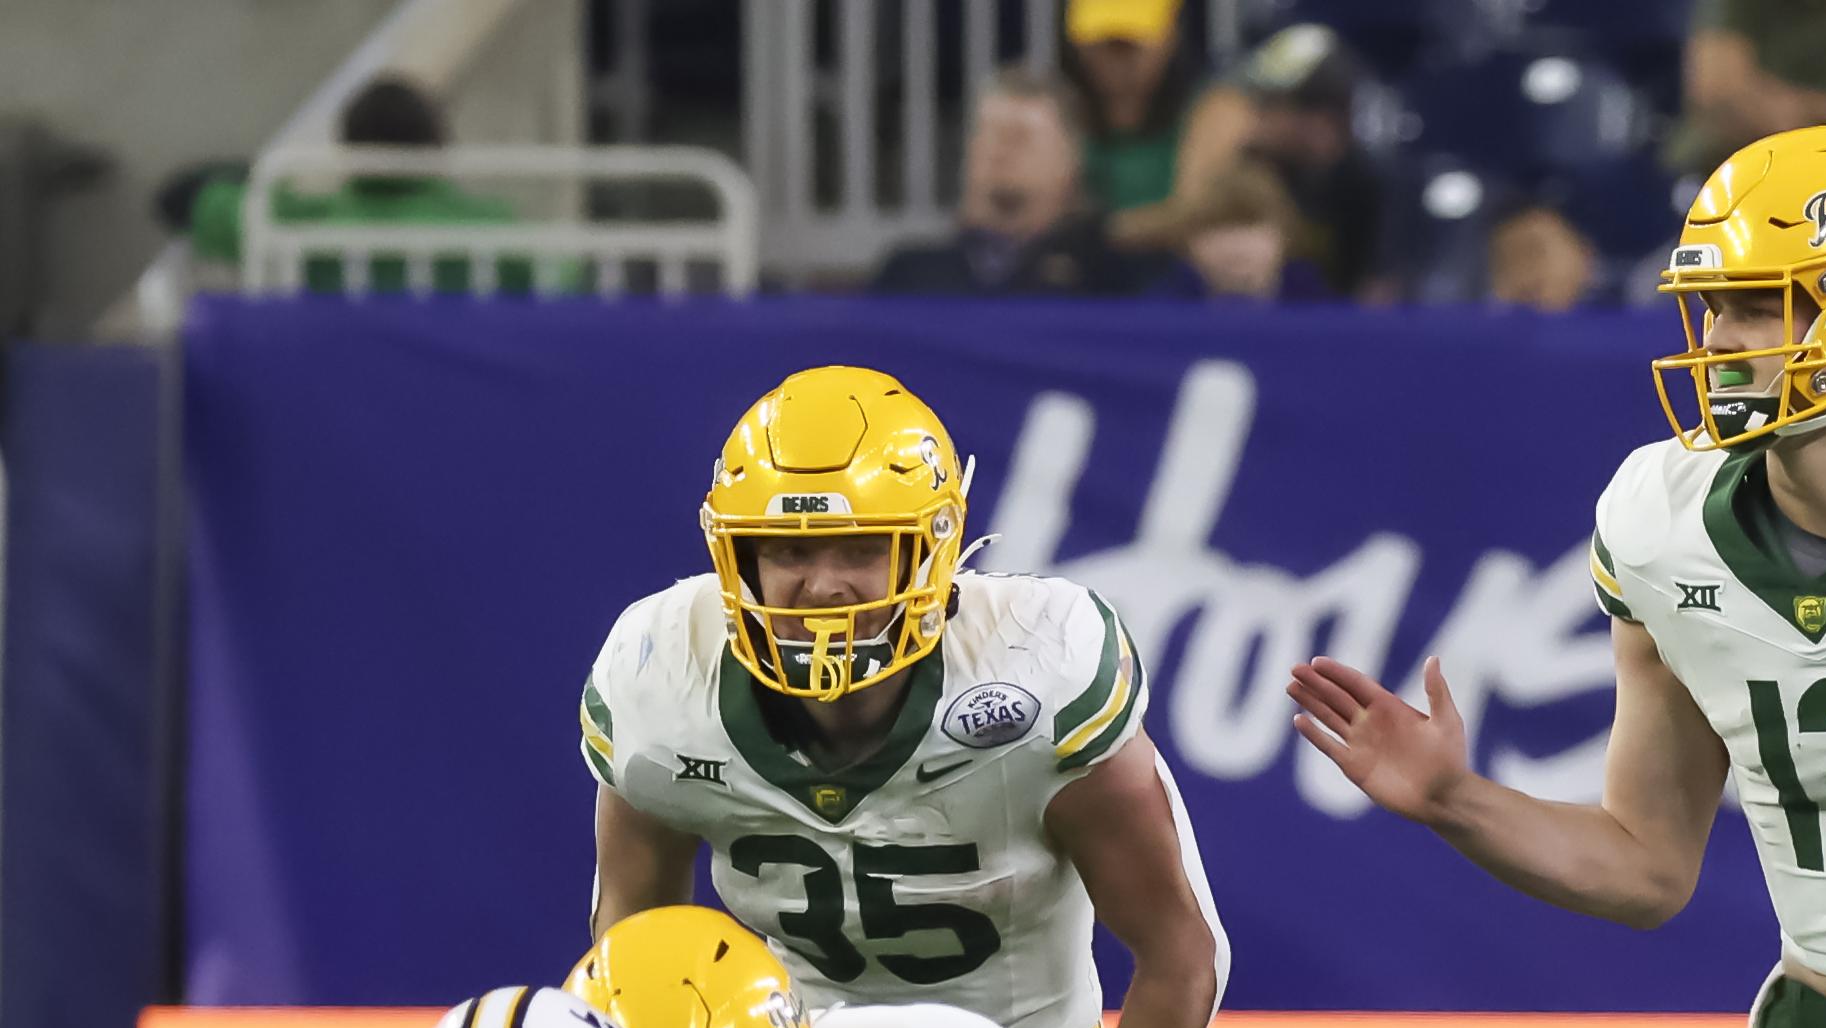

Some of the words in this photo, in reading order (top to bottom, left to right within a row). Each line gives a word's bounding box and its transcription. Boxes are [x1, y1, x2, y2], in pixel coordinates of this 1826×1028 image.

[781, 495, 829, 514] BEARS
[1675, 582, 1722, 612] XII
[957, 700, 1026, 736] TEXAS
[676, 753, 728, 787] XII
[731, 834, 1002, 984] 35
